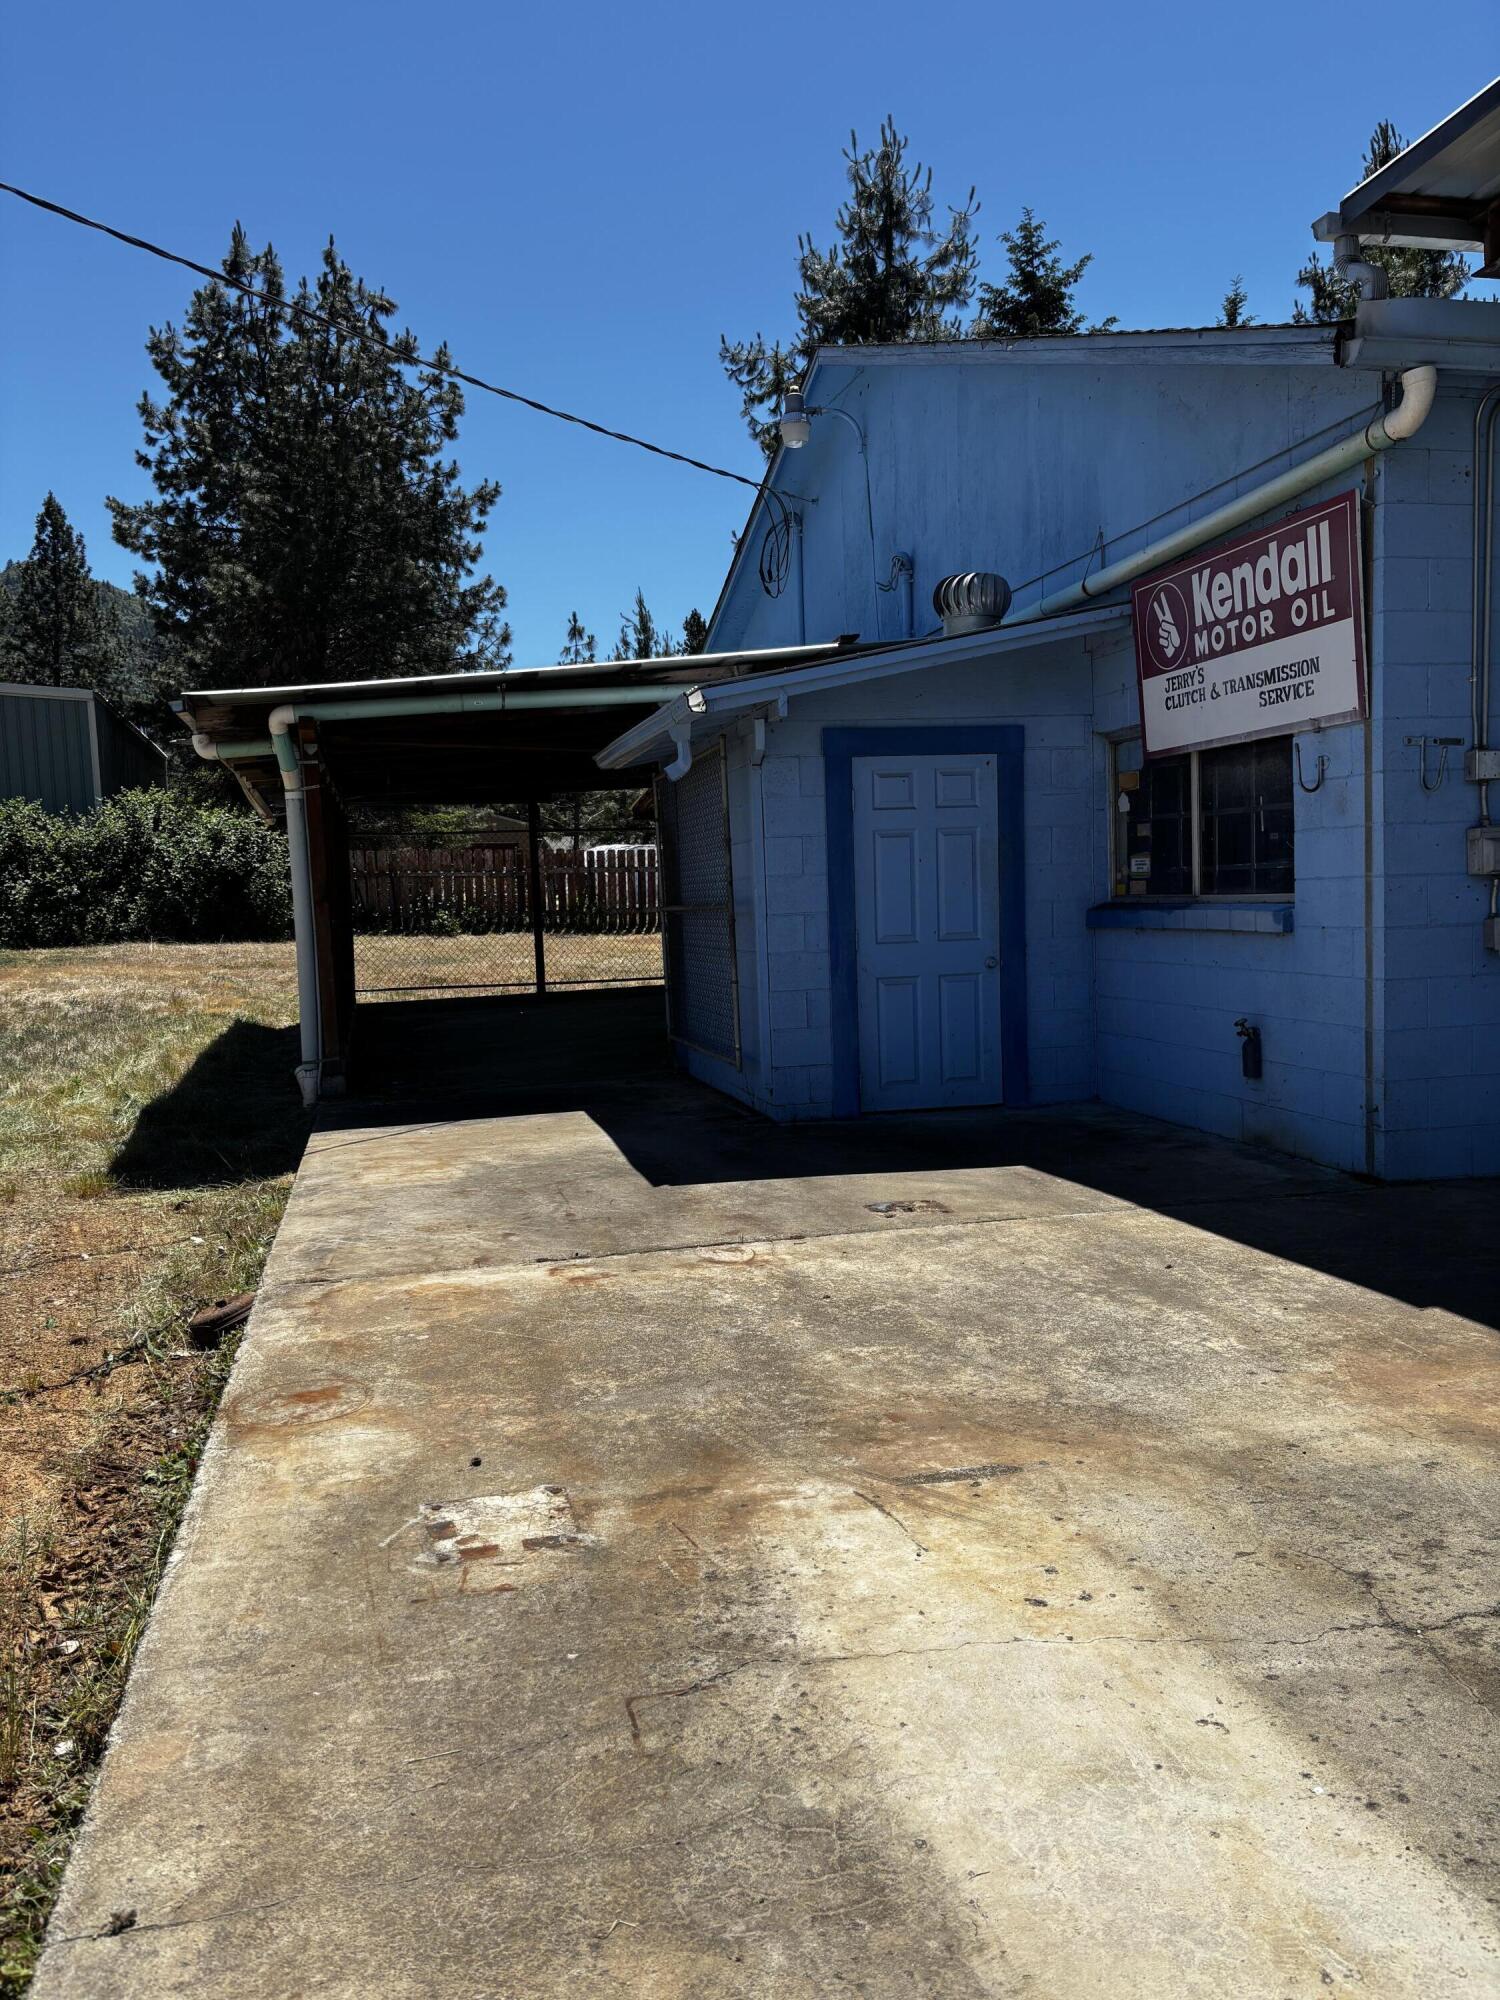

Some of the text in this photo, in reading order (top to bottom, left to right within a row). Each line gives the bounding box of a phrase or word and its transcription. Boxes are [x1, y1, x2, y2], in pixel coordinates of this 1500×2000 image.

[1192, 520, 1332, 627] Kendall
[1194, 590, 1335, 657] MOTOR OIL
[1165, 666, 1205, 693] JERRY'S
[1165, 656, 1321, 711] CLUTCH & TRANSMISSION
[1259, 680, 1315, 708] SERVICE
